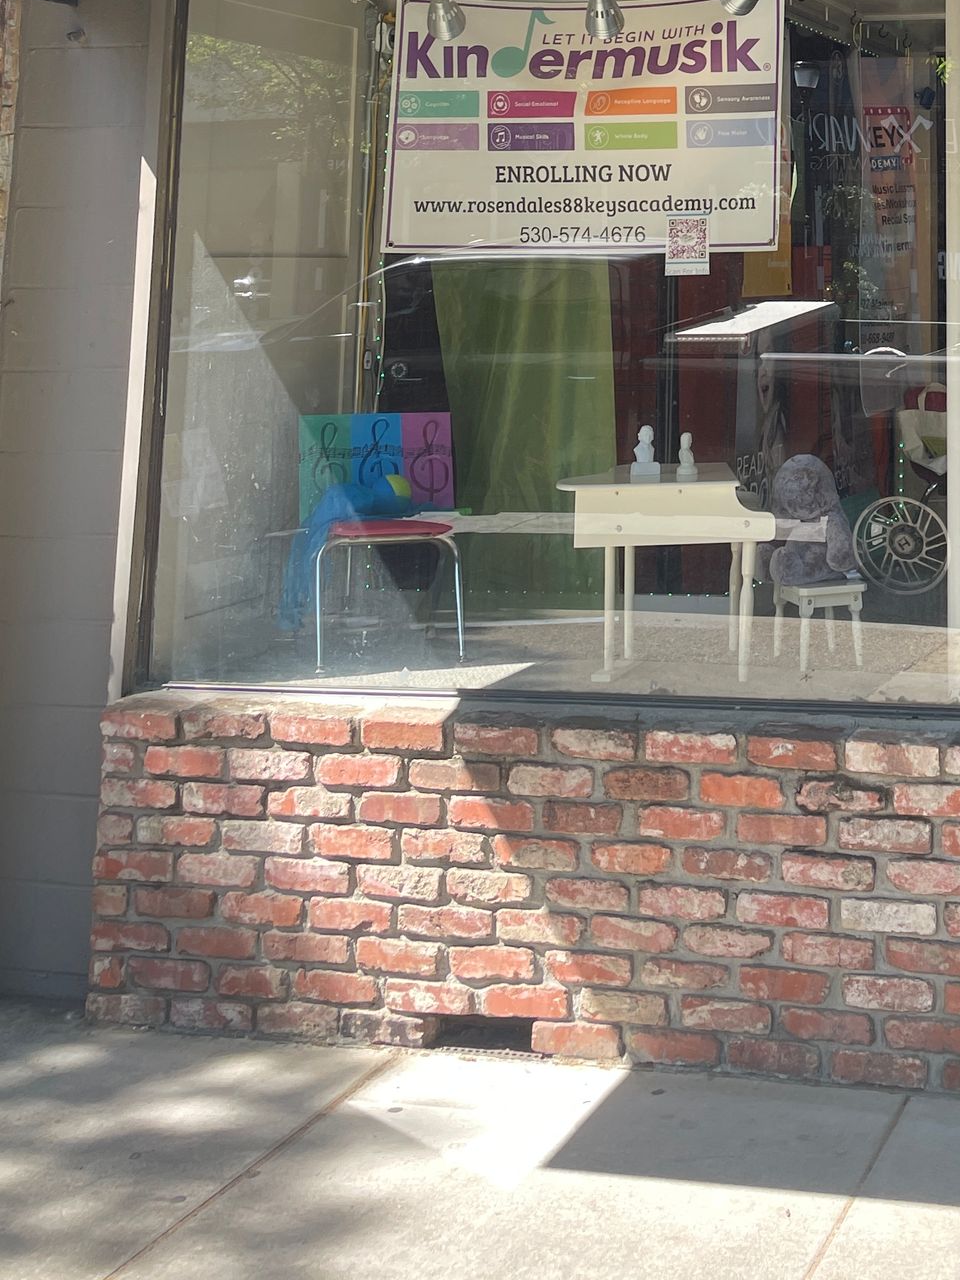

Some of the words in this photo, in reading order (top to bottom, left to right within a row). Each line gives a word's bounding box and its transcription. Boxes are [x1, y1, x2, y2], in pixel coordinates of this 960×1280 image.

[542, 33, 576, 46] LET
[602, 30, 655, 45] BEGIN
[662, 23, 706, 40] WITH
[495, 164, 613, 184] ENROLLING
[618, 163, 672, 182] NOW
[413, 194, 757, 217] www.rosendales88keysacademy.com
[519, 225, 647, 244] 530-574-4676
